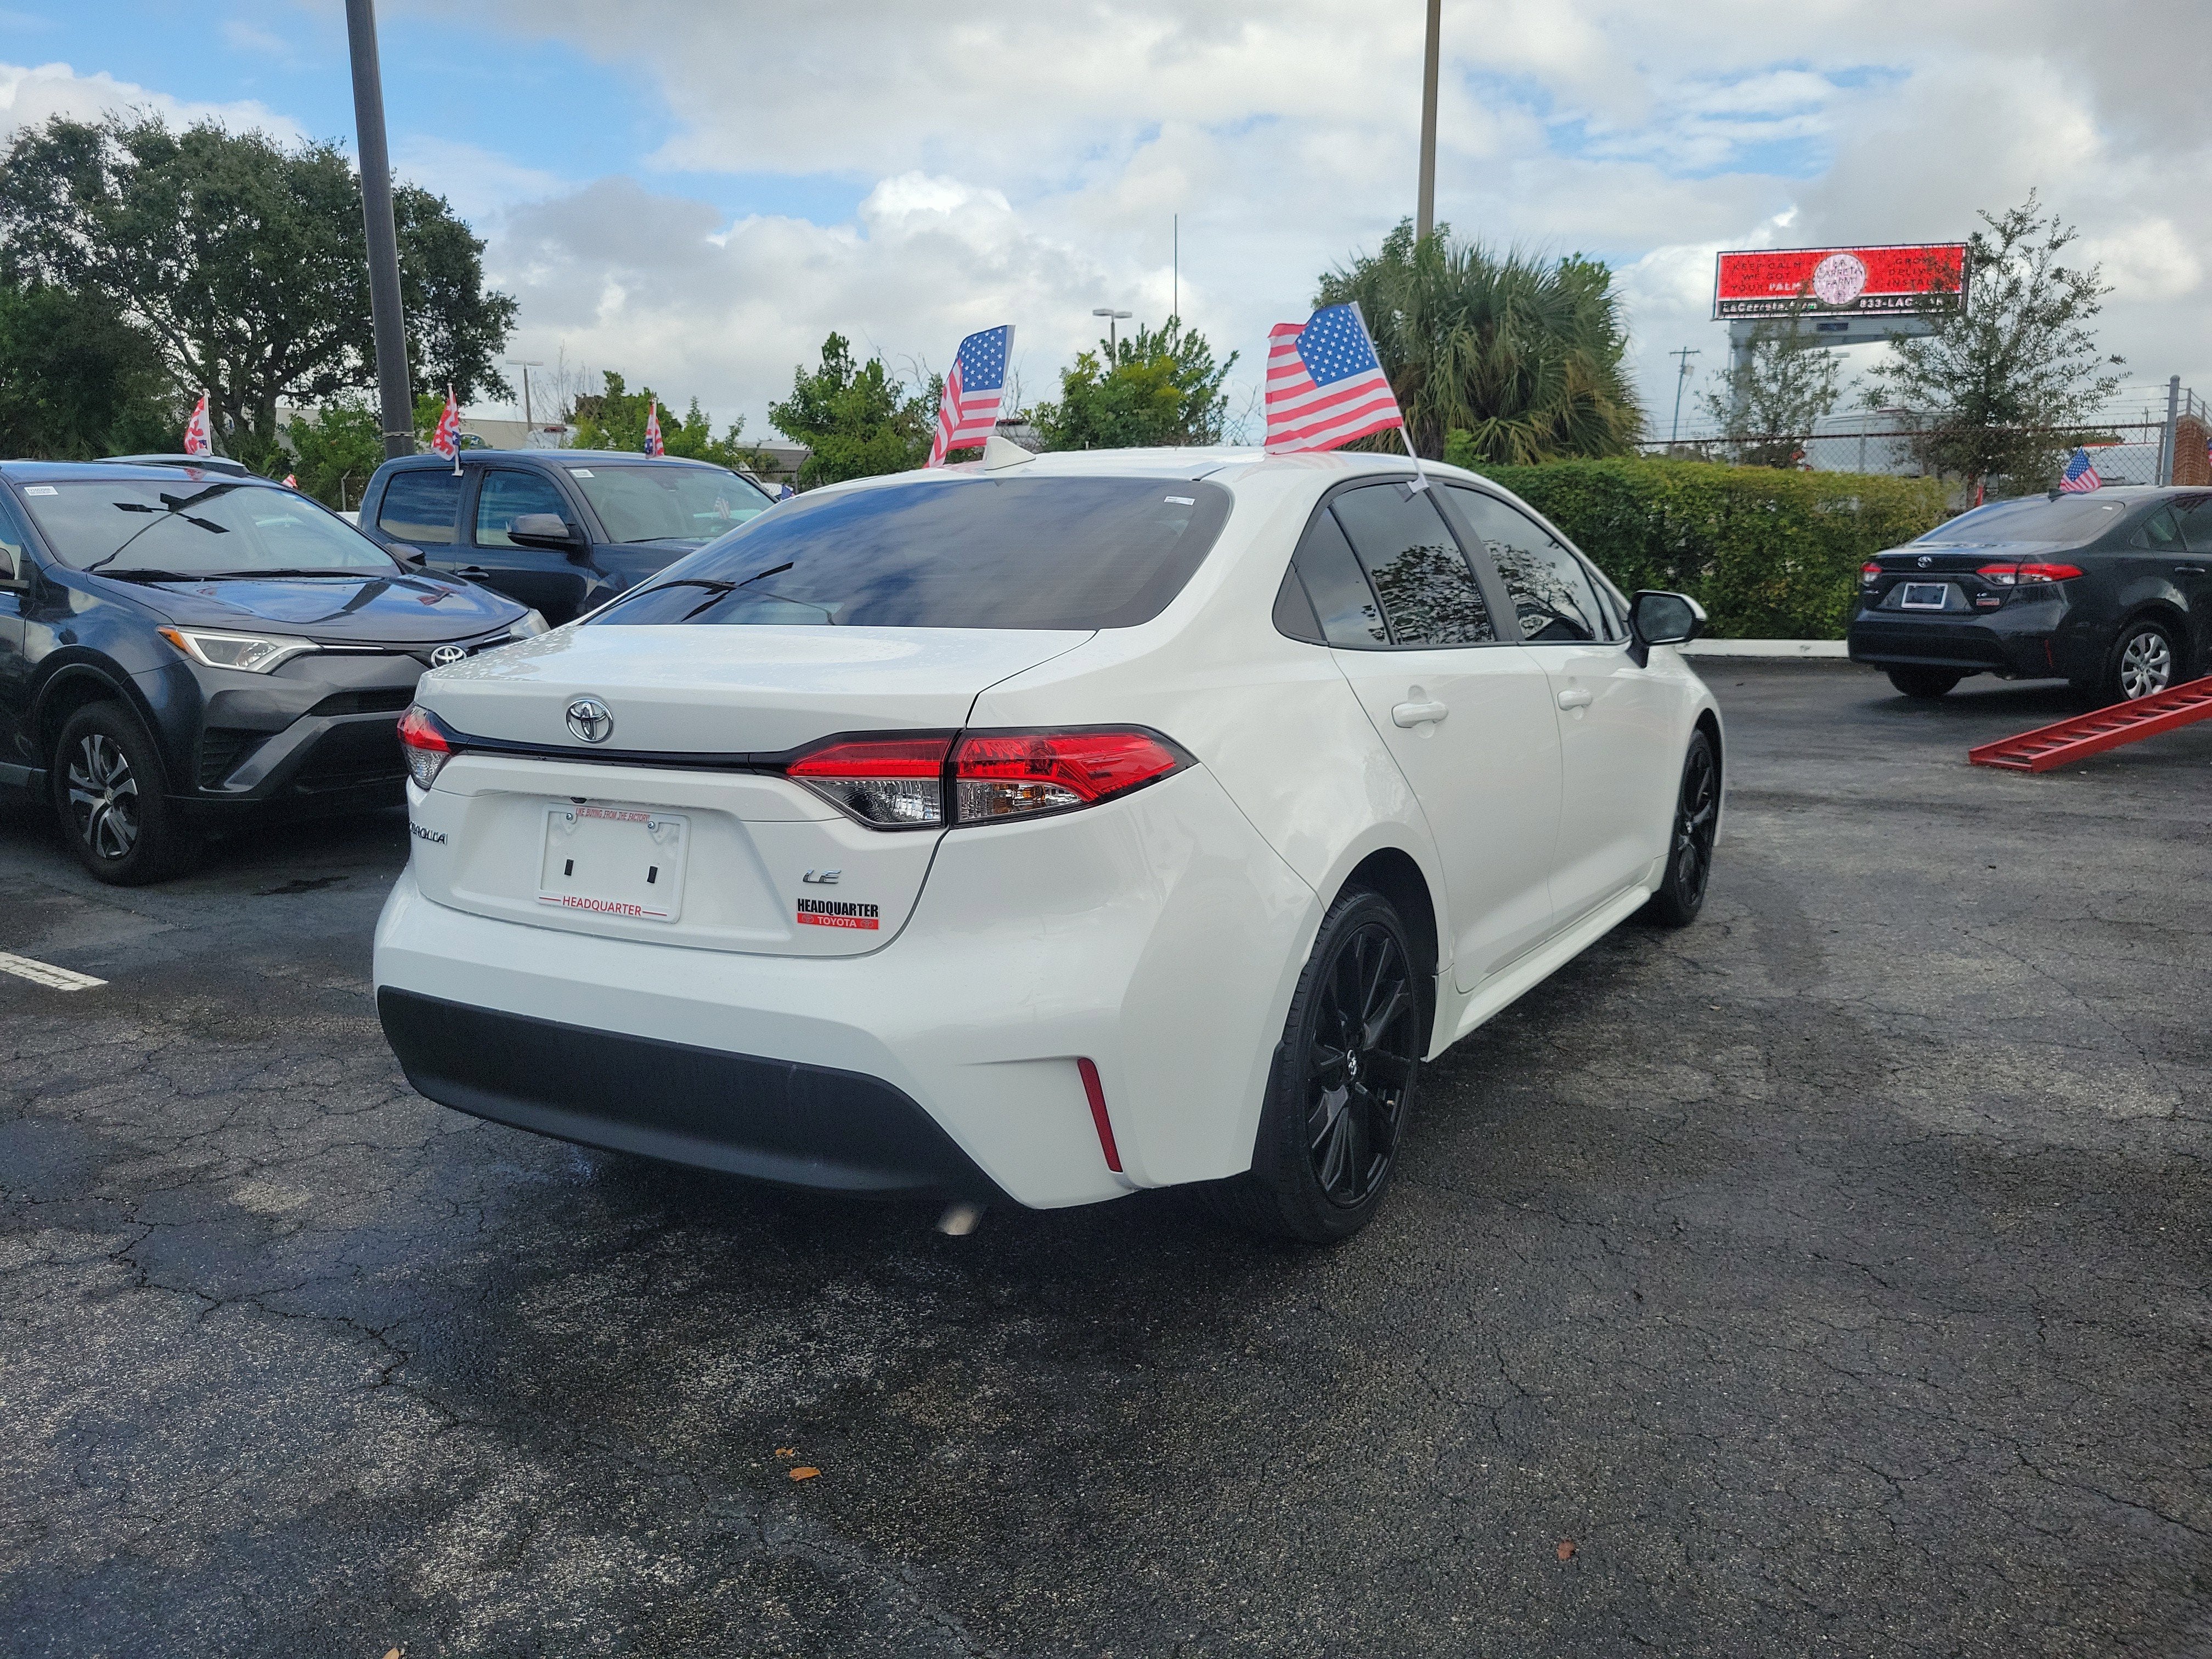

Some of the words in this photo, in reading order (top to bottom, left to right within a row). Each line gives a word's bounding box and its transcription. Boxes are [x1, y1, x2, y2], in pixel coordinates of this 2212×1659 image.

[586, 808, 603, 818] BUYING
[603, 810, 617, 819] FROM
[618, 811, 628, 821] THE
[409, 821, 448, 845] OROLLA
[803, 869, 842, 884] LE
[563, 896, 641, 917] HEADQUARTER
[797, 898, 878, 918] HEADQUARTER
[817, 916, 857, 928] TOYOTA
